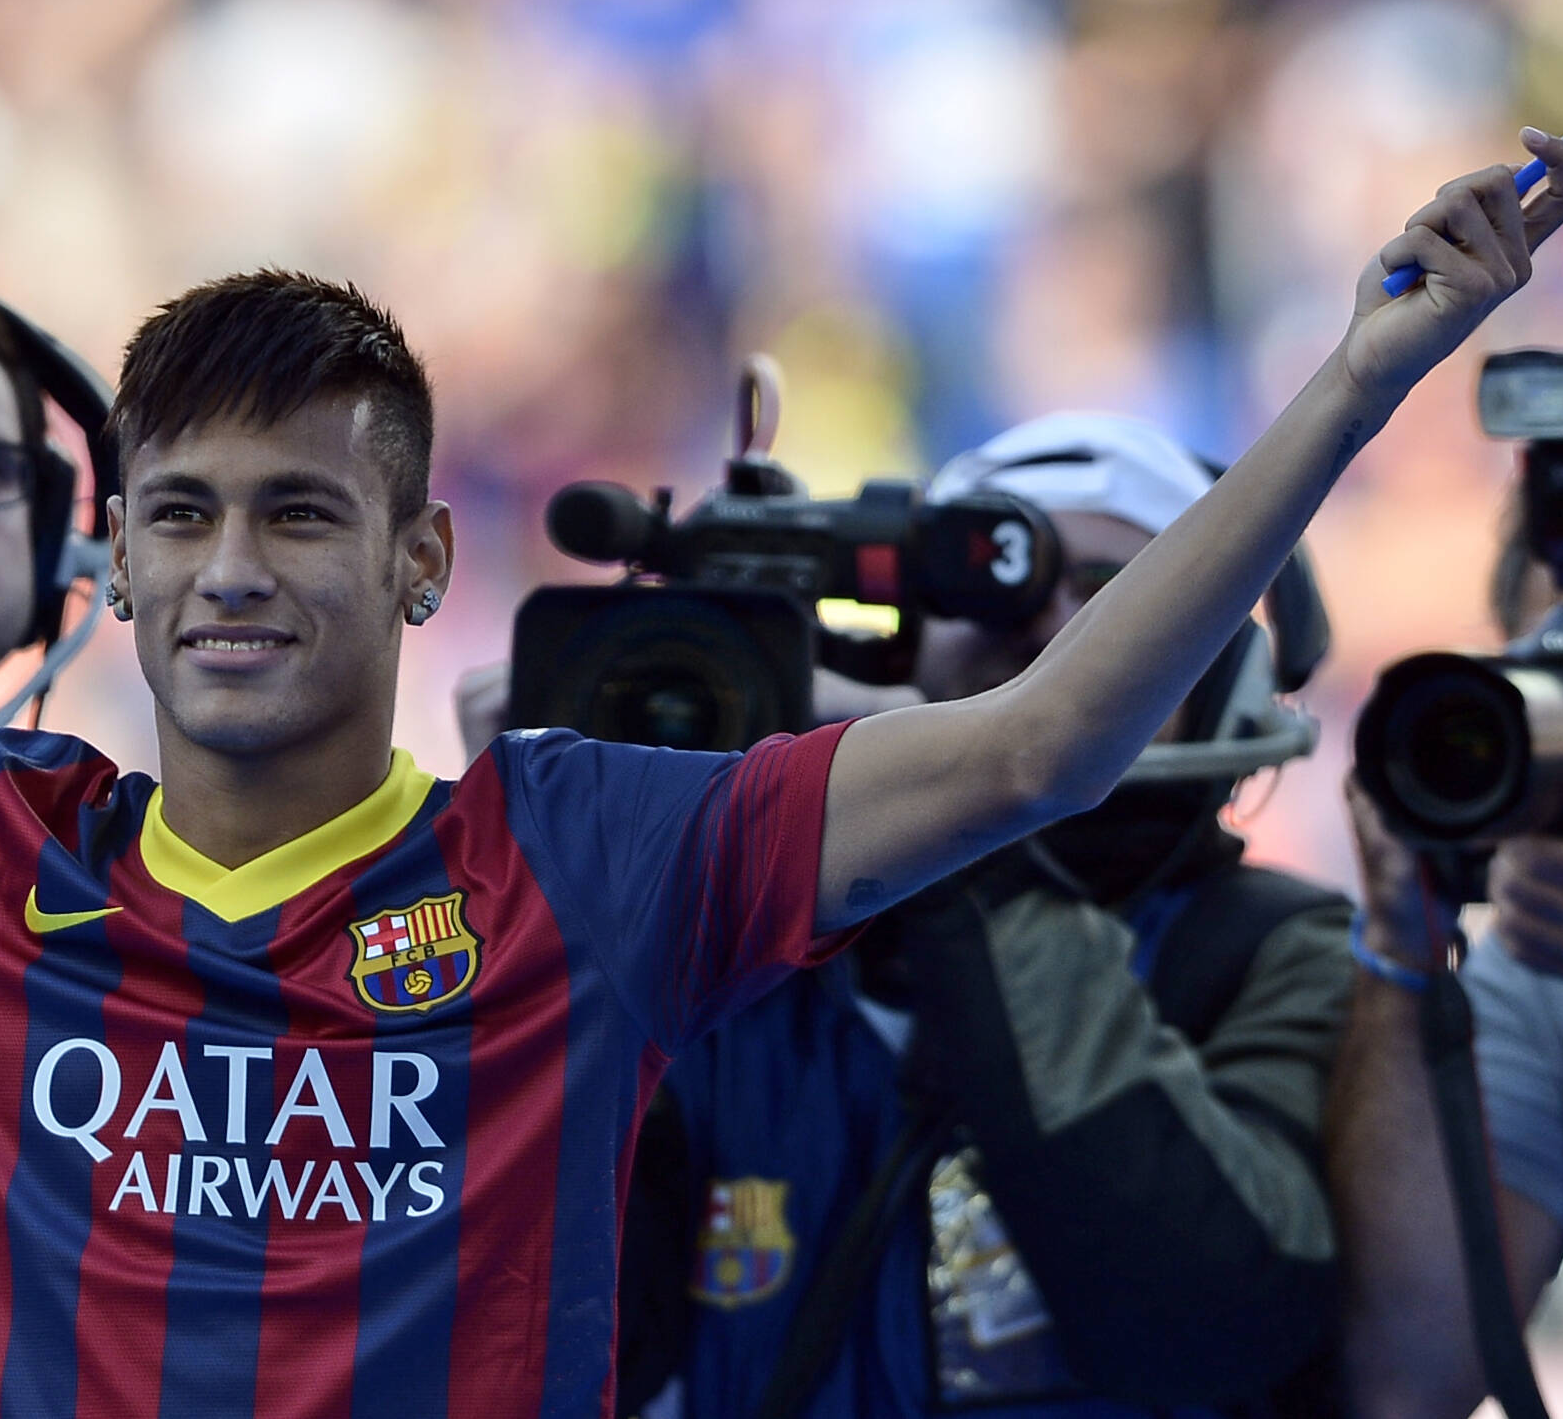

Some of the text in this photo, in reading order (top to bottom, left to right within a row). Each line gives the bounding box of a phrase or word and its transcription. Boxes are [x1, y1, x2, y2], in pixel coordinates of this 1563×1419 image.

[990, 521, 1032, 585] 3
[391, 945, 436, 967] FCB
[33, 1038, 446, 1163] QATAR
[108, 1151, 445, 1222] AIRWAYS
